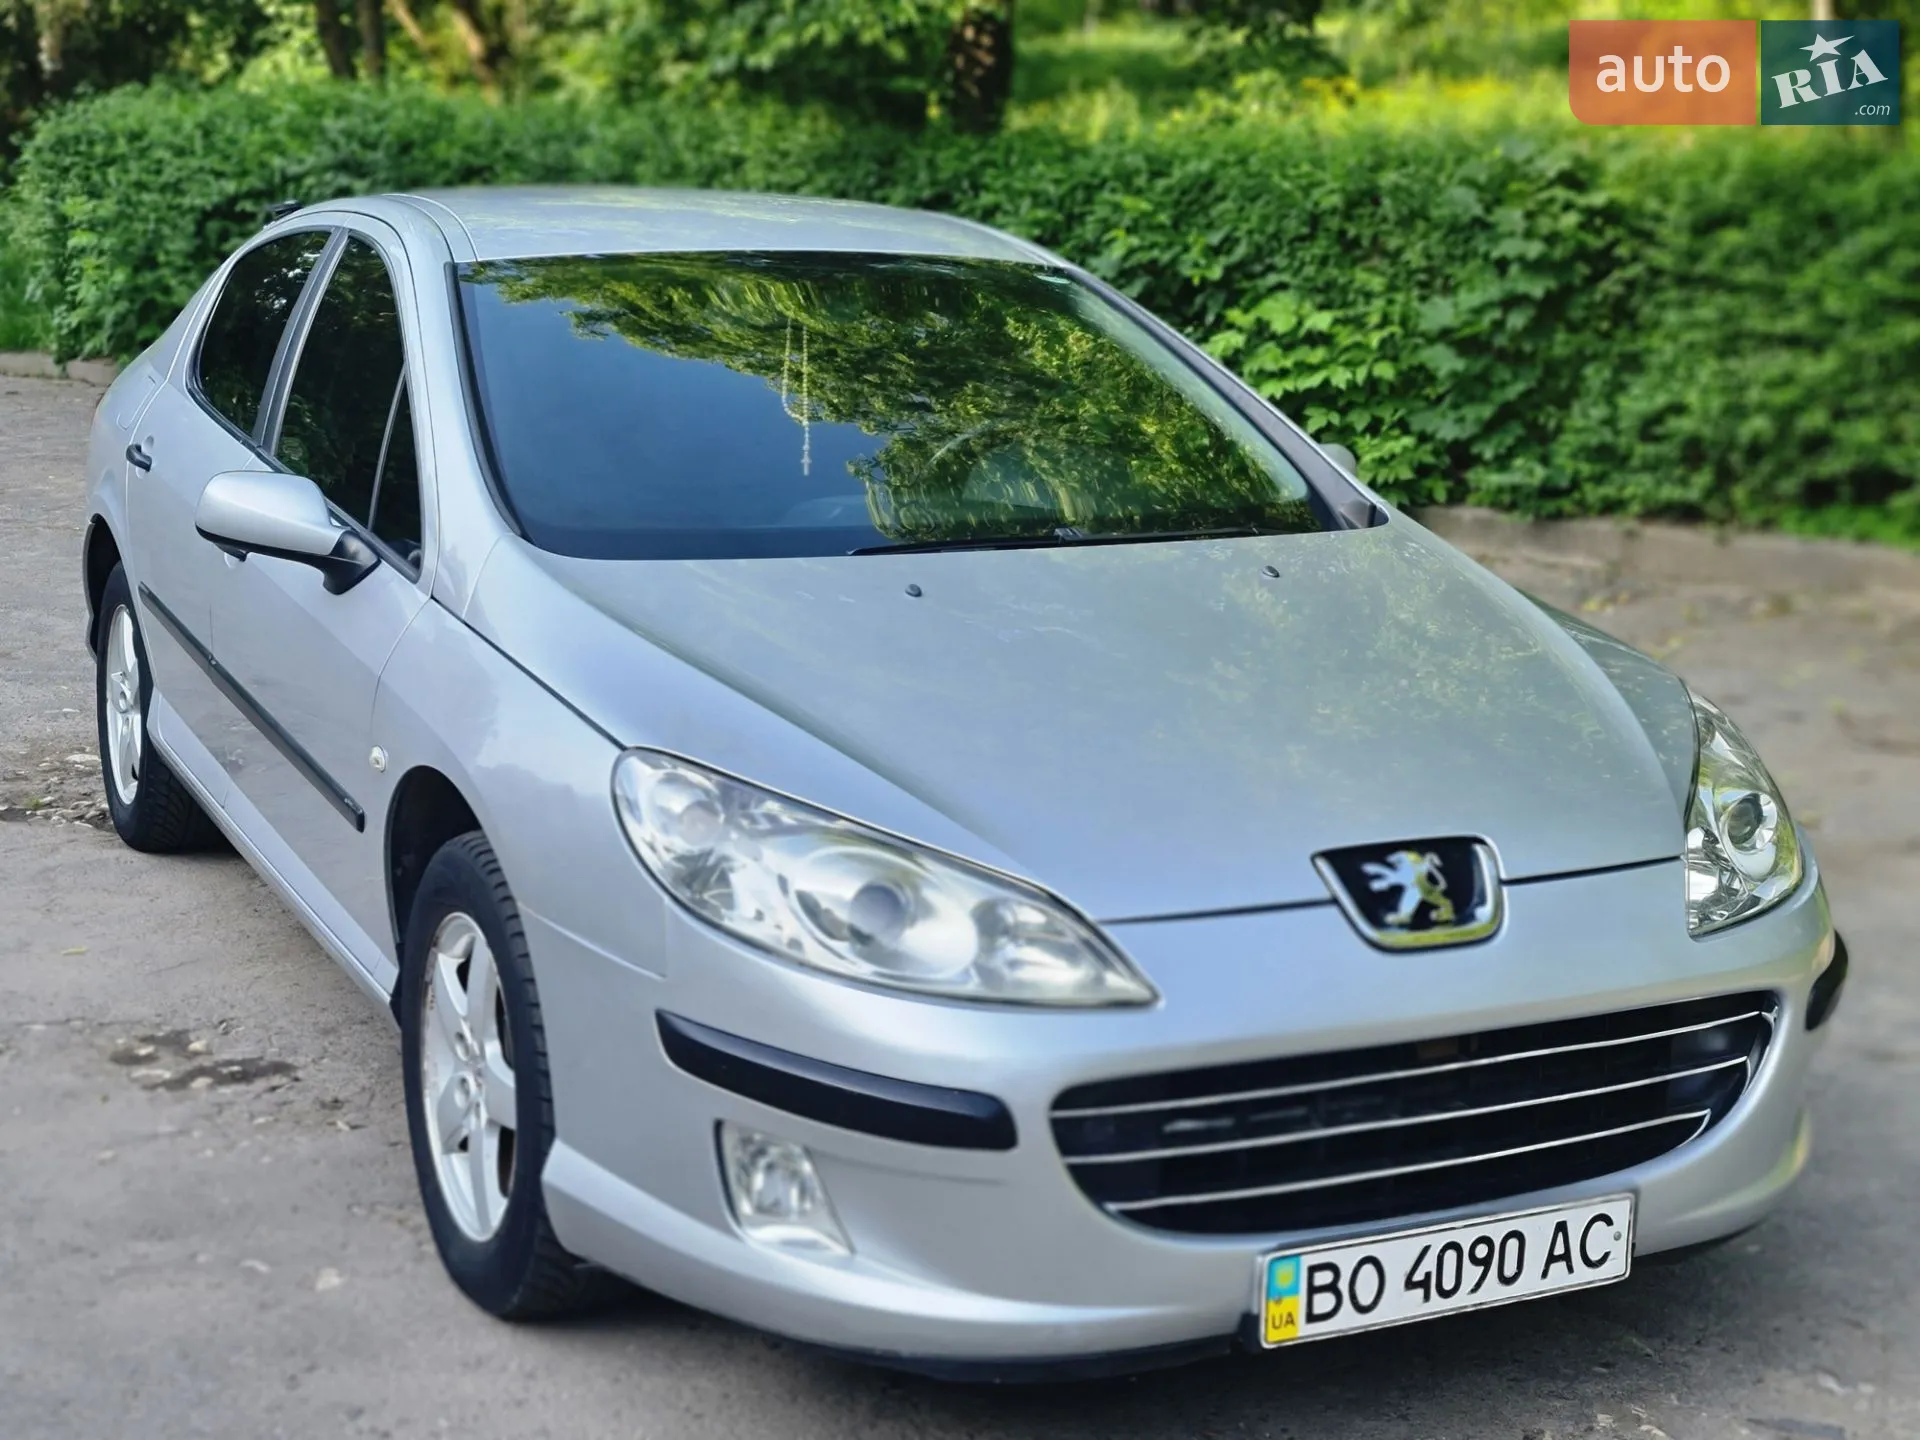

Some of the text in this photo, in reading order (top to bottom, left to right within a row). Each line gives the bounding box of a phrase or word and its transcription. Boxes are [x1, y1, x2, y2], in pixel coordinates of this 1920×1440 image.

[1304, 1212, 1615, 1325] BO 4090 AC
[1270, 1310, 1296, 1330] UA
